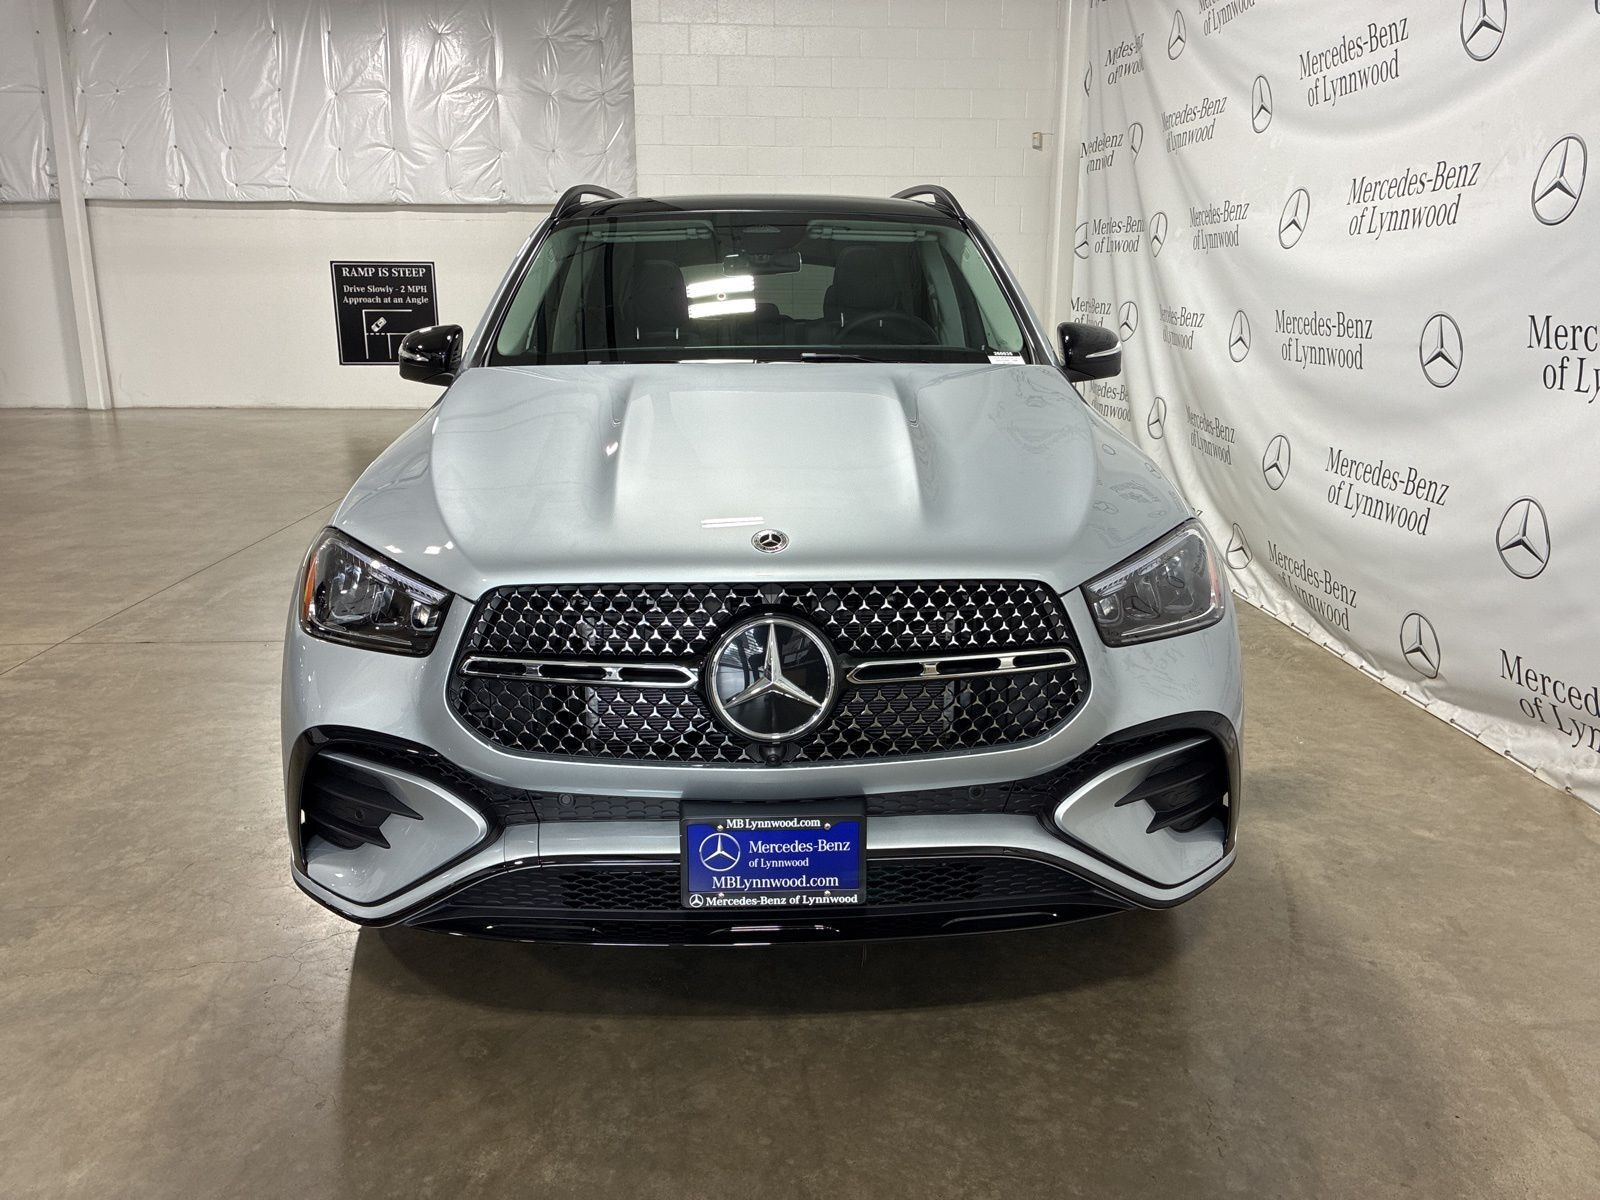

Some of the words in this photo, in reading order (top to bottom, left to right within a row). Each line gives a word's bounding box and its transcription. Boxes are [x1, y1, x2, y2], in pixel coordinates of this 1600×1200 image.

[1203, 10, 1211, 36] of
[1300, 18, 1409, 80] Mercedes-Benz
[1307, 78, 1320, 107] of
[1322, 49, 1400, 106] Lynnwood
[1346, 161, 1482, 205] Mercedes-Benz
[1190, 200, 1250, 228] Mercedes-Benz
[1348, 206, 1369, 236] of
[1367, 193, 1462, 240] Lynnwood
[1094, 237, 1106, 254] of
[1193, 229, 1200, 251] of
[1201, 224, 1239, 254] Lynnwood
[342, 267, 375, 277] RAMP
[378, 268, 389, 277] IS
[391, 267, 426, 277] STEEP
[343, 285, 365, 293] Drive
[367, 285, 393, 294] Slowly
[400, 285, 406, 293] 2
[407, 285, 427, 293] MPH
[343, 296, 381, 305] Approach
[405, 296, 429, 305] Angle
[1275, 309, 1373, 340] Mercedes-Benz
[1281, 337, 1293, 361] of
[1294, 338, 1364, 370] Lynnwood
[1542, 355, 1570, 391] of
[1325, 446, 1450, 506] Mercedes-Benz
[1327, 480, 1346, 506] of
[1344, 482, 1431, 536] Lynnwood
[1267, 540, 1357, 608] Mercedes-Benz
[1519, 696, 1548, 725] of
[748, 839, 851, 854] Mercedes-Benz
[748, 858, 759, 868] of
[760, 857, 809, 870] Lynnwood
[711, 874, 839, 891] MBLynnwood.com
[705, 894, 787, 906] Mercedes-Benz
[789, 894, 801, 904] of
[802, 894, 858, 905] Lynnwood
